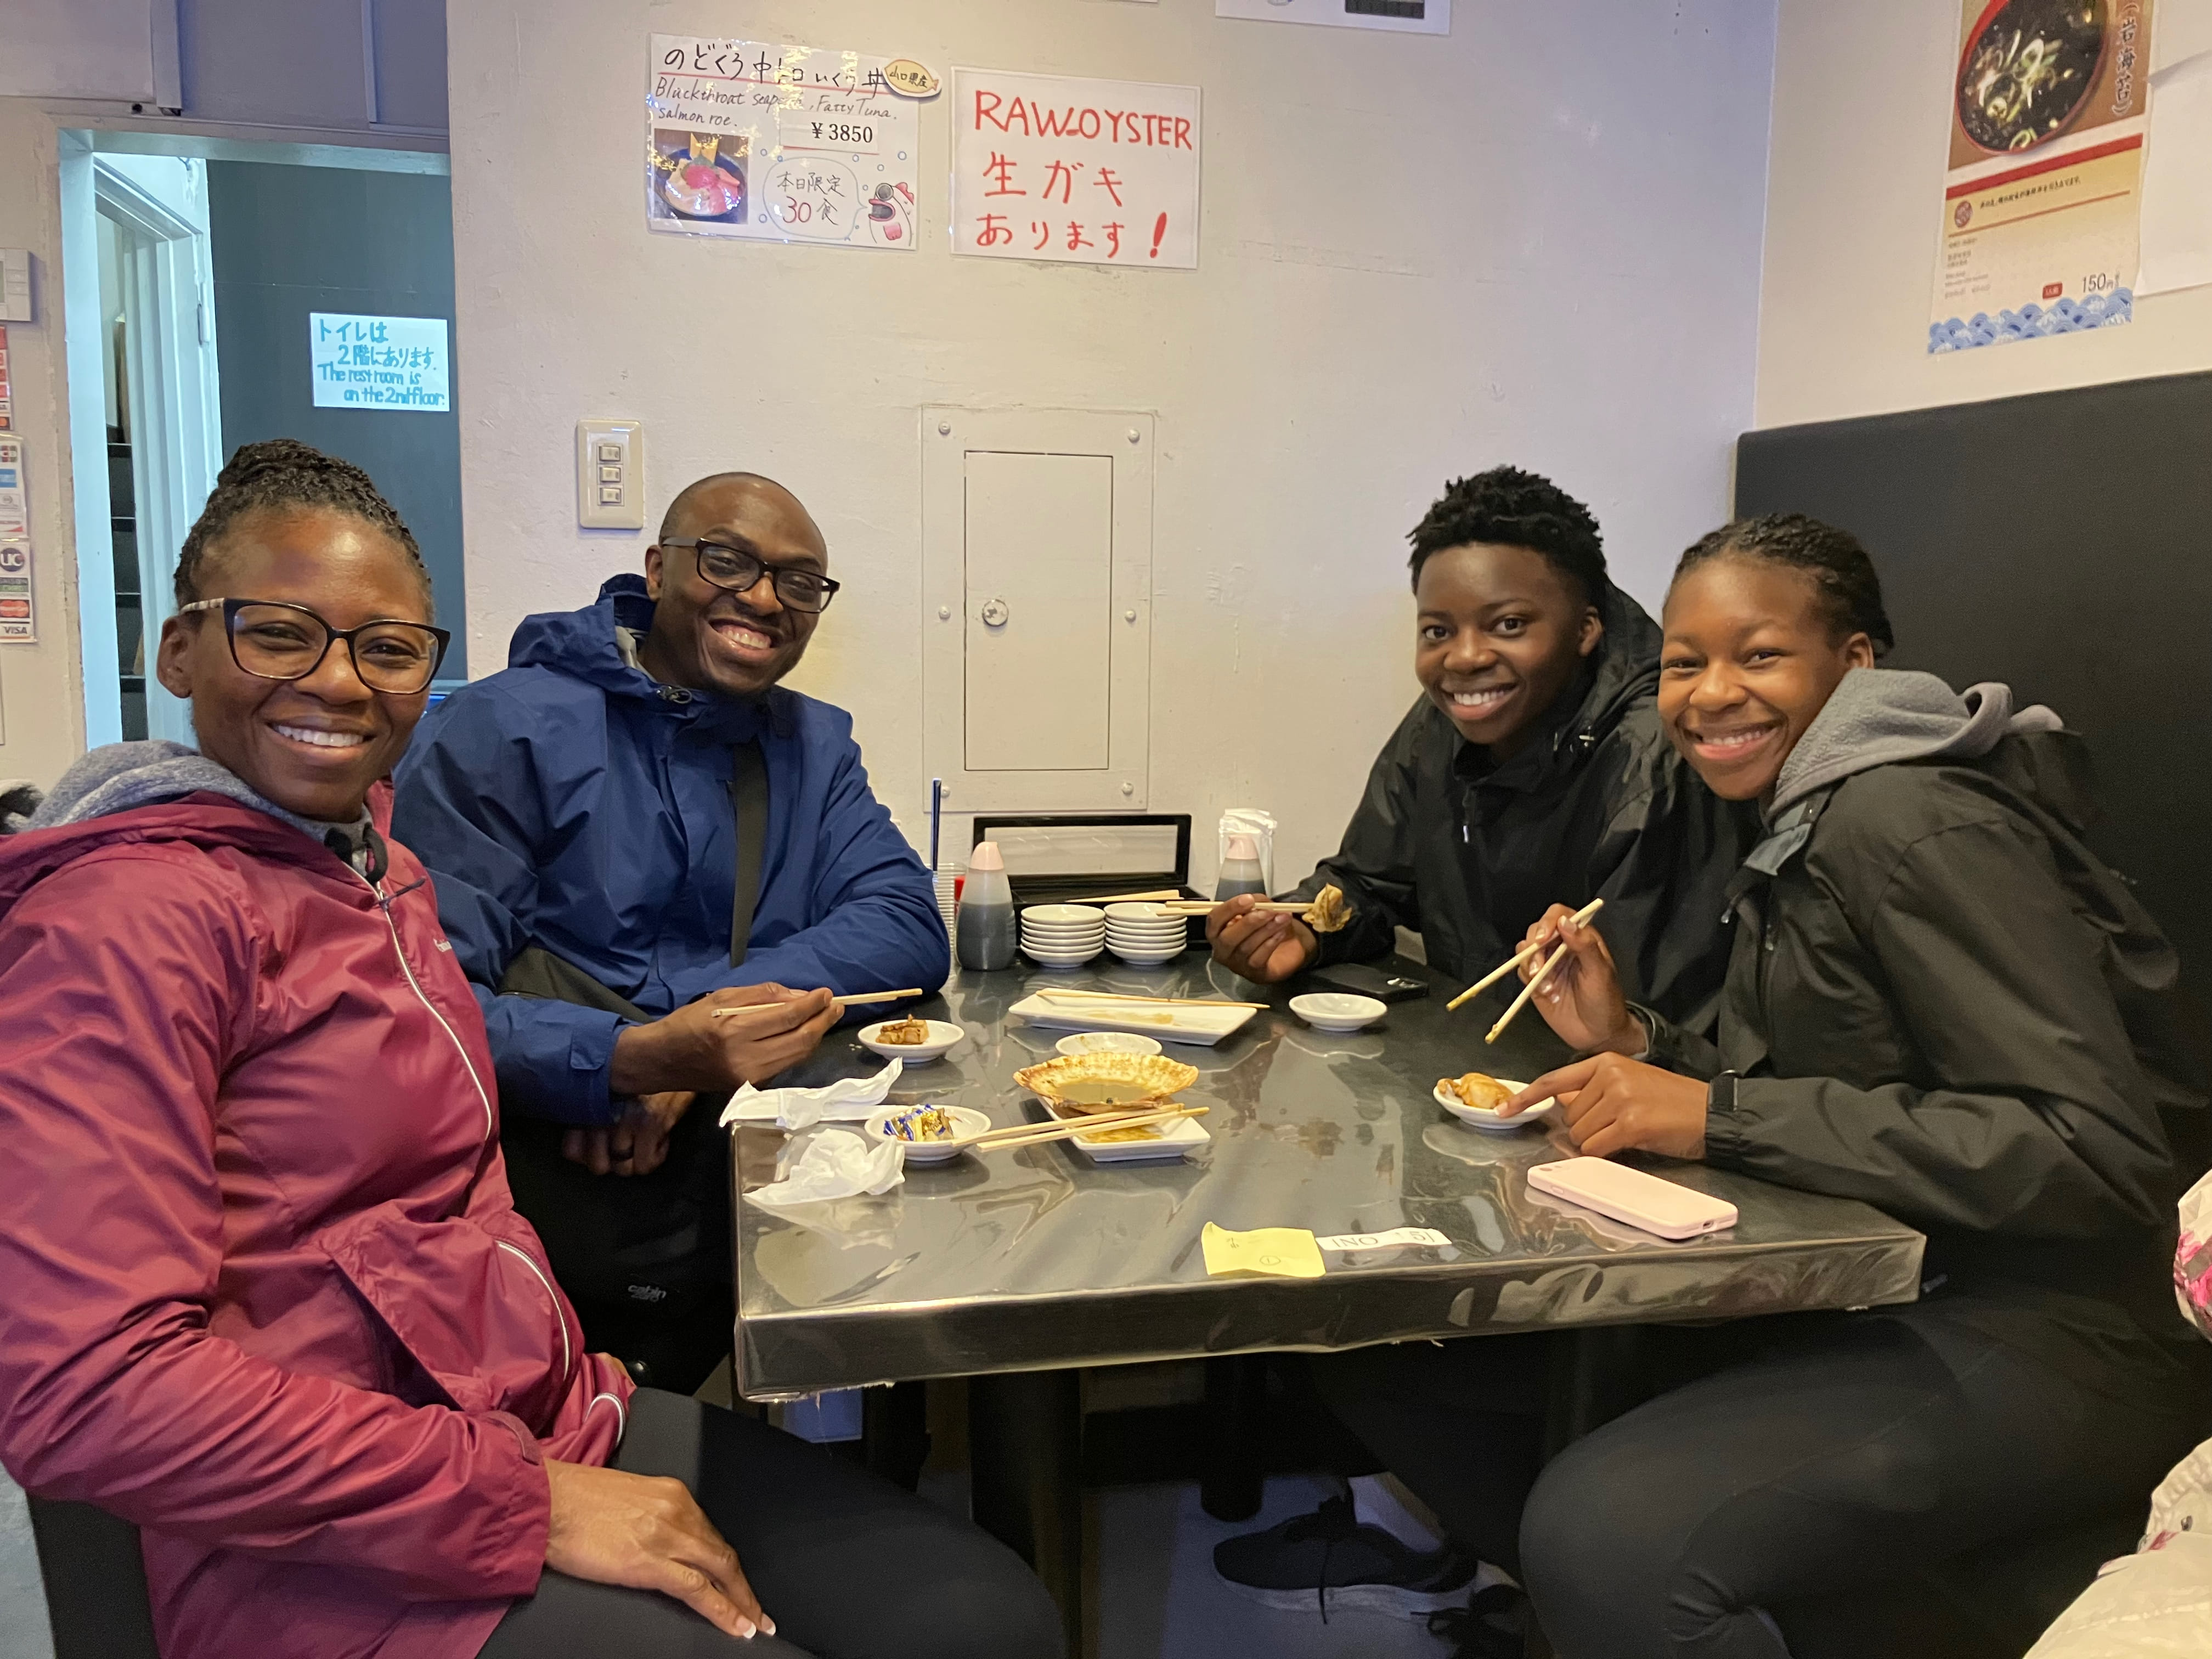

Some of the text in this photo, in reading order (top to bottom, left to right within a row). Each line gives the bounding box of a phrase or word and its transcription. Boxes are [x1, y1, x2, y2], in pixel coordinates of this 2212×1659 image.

[656, 76, 745, 105] Blackthroat
[658, 104, 704, 123] salmon
[776, 171, 845, 198] 本日限定
[319, 318, 389, 343] トイレは
[317, 361, 346, 381] The
[409, 371, 422, 385] is
[343, 389, 359, 402] on
[361, 385, 383, 403] the
[4, 626, 28, 635] VISA
